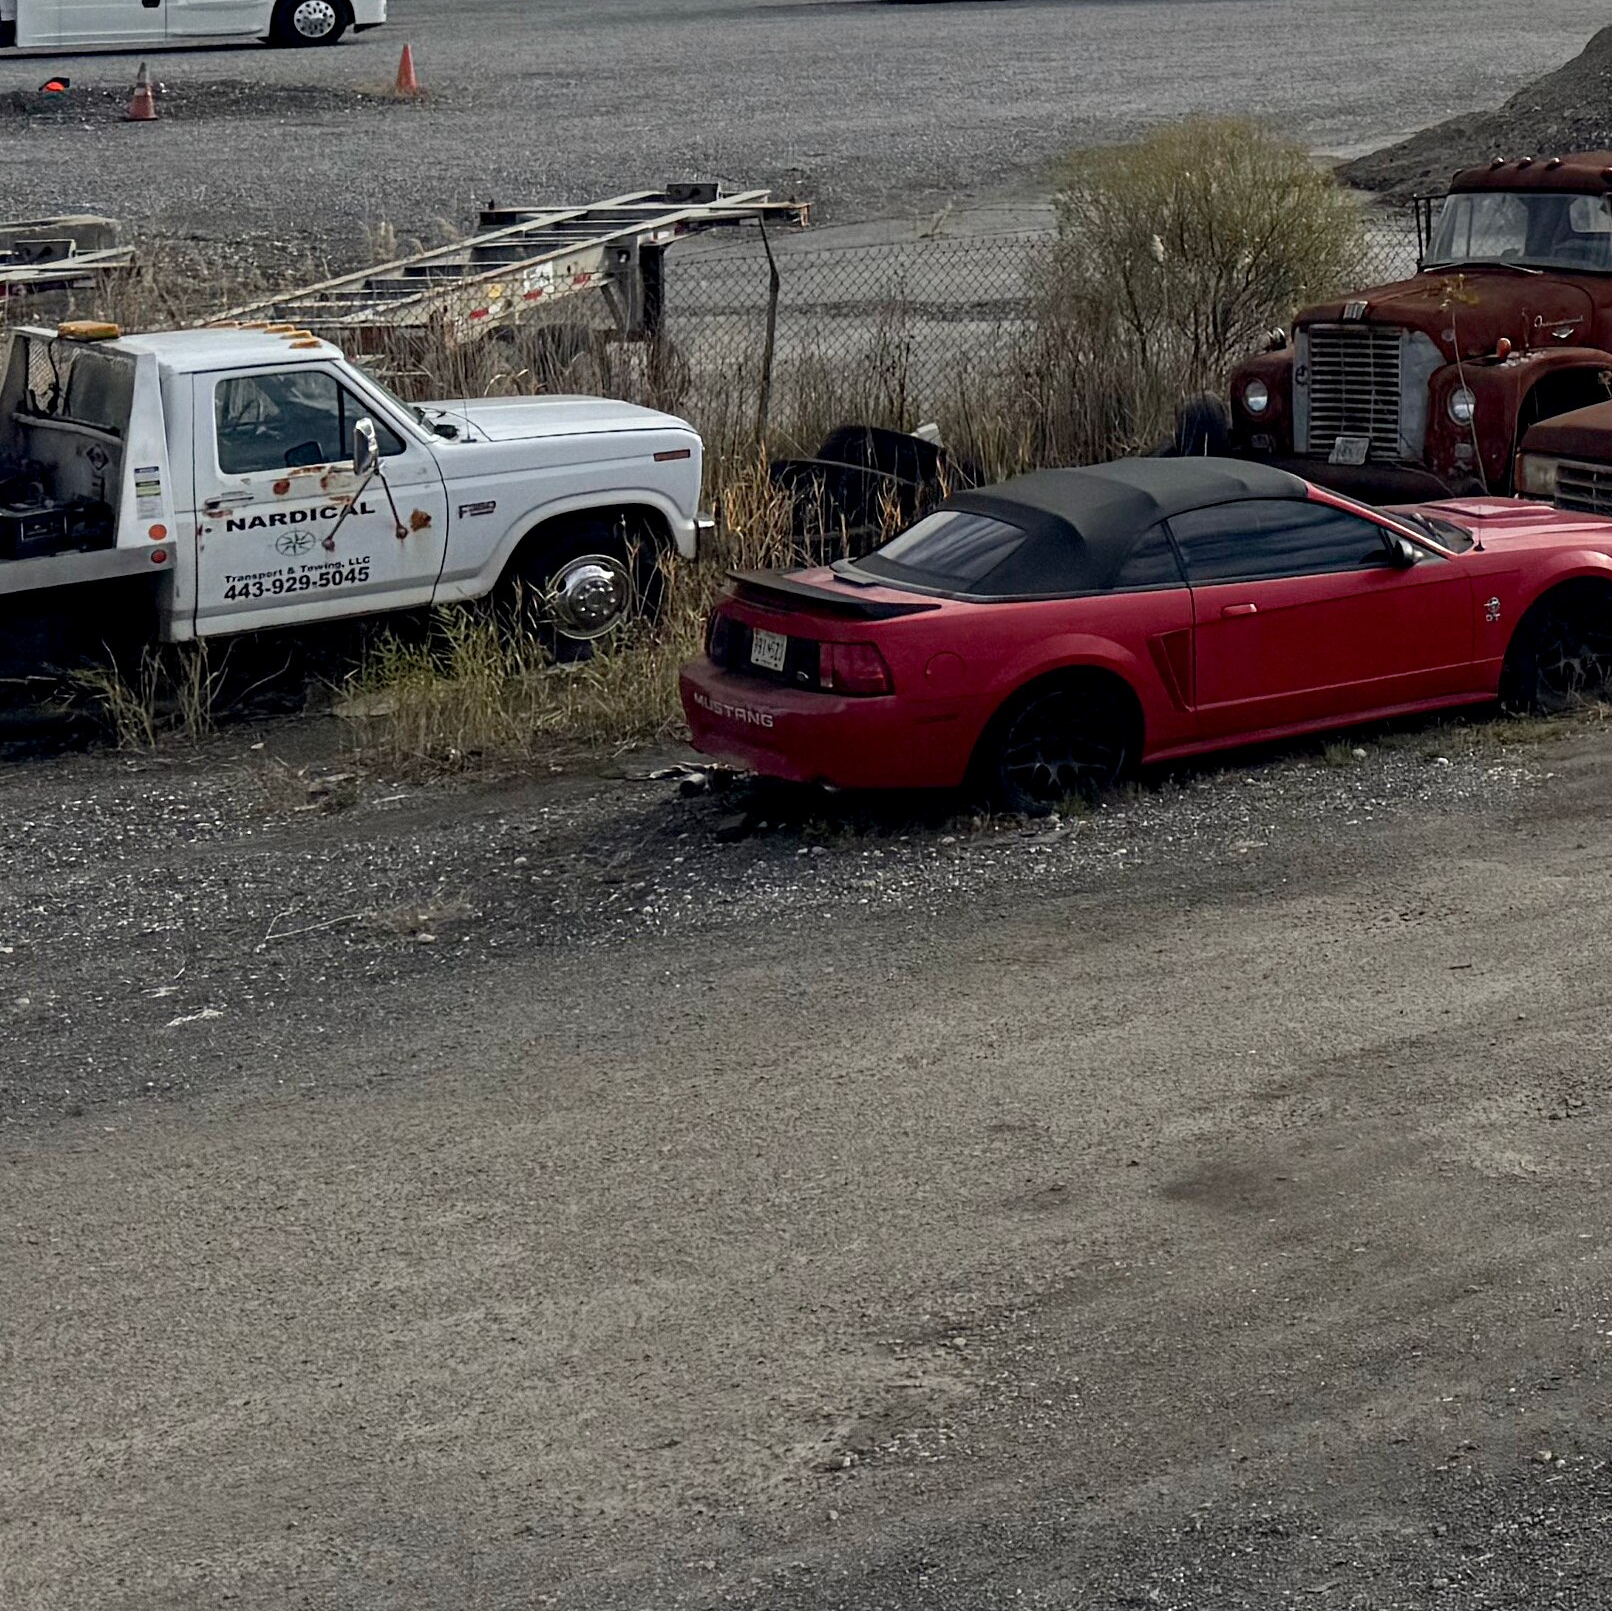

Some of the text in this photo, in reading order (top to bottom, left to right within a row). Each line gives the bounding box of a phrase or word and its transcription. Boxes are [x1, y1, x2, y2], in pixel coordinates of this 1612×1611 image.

[226, 502, 375, 532] NARDICAL
[224, 566, 370, 600] 443-929-5045
[225, 569, 282, 583] Transport
[301, 561, 344, 573] Towing,
[348, 556, 370, 566] LLC
[694, 693, 774, 728] MUSTANG
